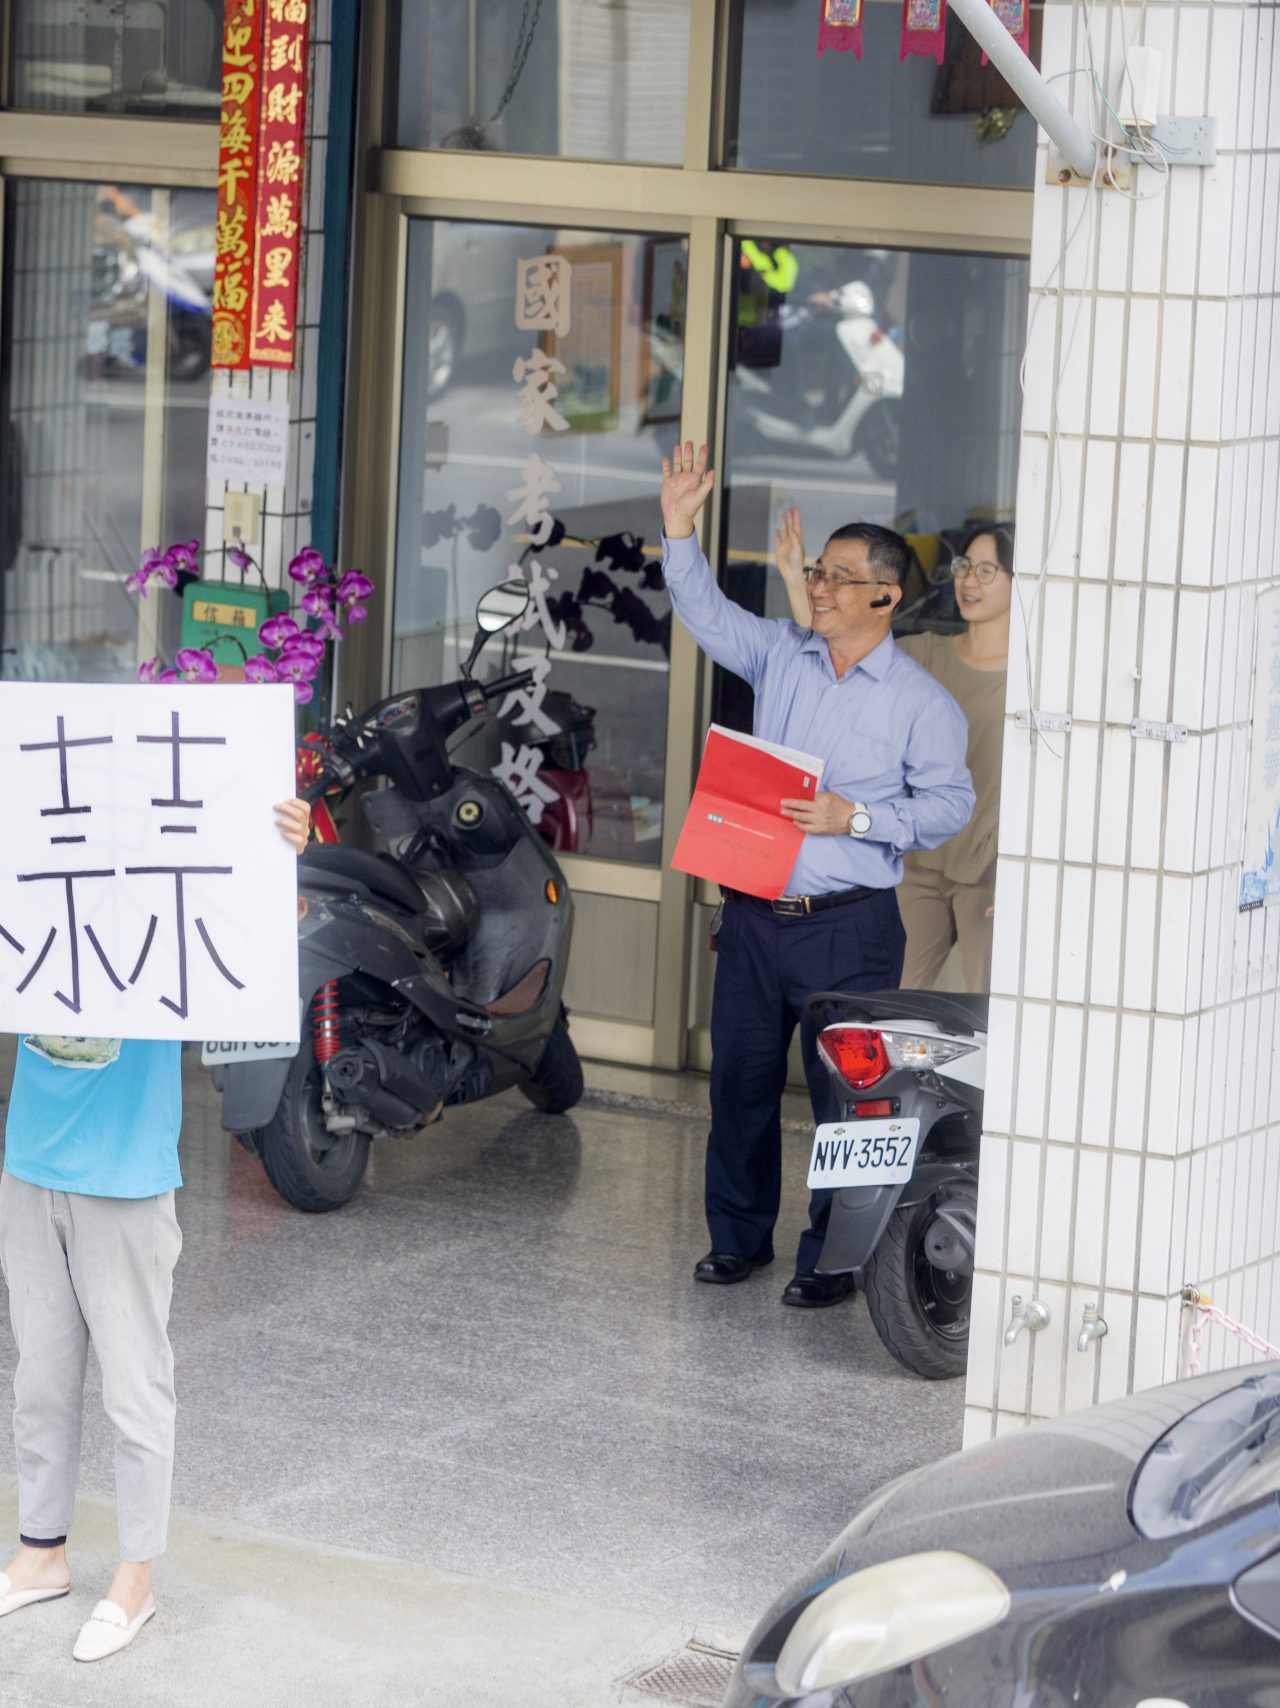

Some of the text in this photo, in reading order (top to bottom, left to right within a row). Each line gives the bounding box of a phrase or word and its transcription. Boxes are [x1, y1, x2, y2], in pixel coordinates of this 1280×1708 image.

[204, 604, 245, 628] 信箱
[492, 253, 572, 826] 國家考試及格
